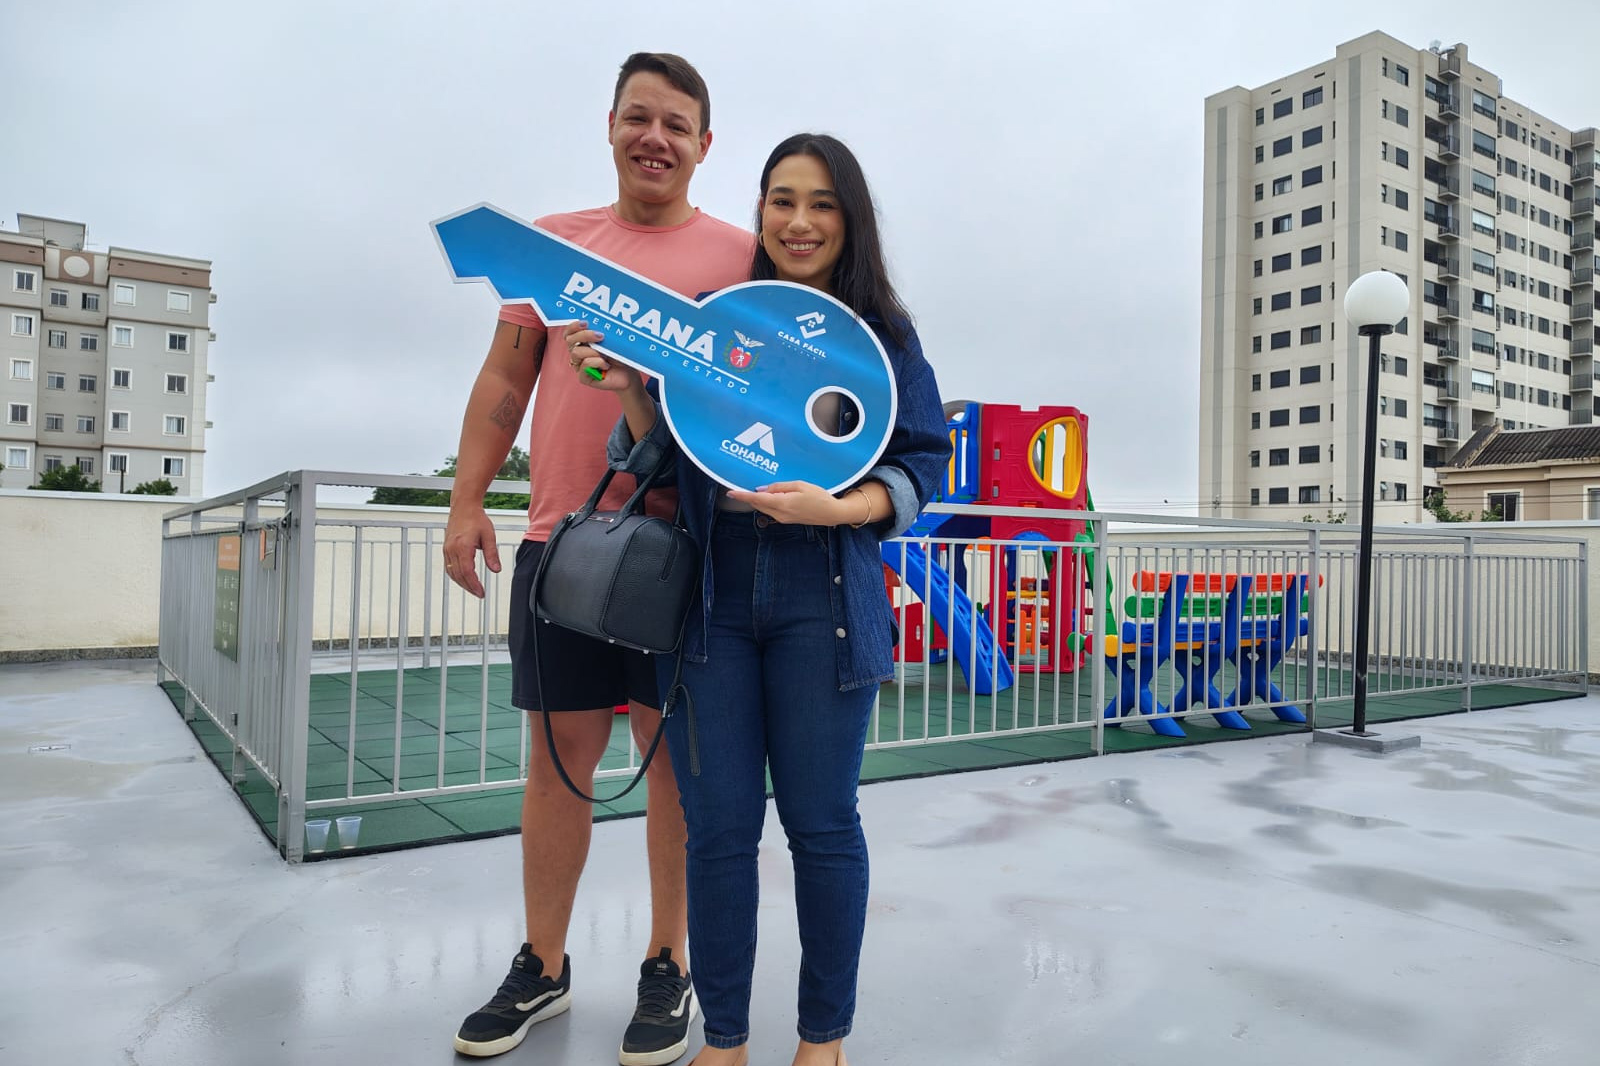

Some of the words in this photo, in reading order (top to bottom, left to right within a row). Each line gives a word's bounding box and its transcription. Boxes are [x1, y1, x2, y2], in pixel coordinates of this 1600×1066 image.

[556, 300, 636, 342] GOVERNO
[649, 344, 669, 358] DO
[682, 360, 748, 394] ESTADO
[563, 271, 717, 362] PARANÁ
[777, 331, 801, 346] CASA
[721, 439, 780, 472] COHAPAR
